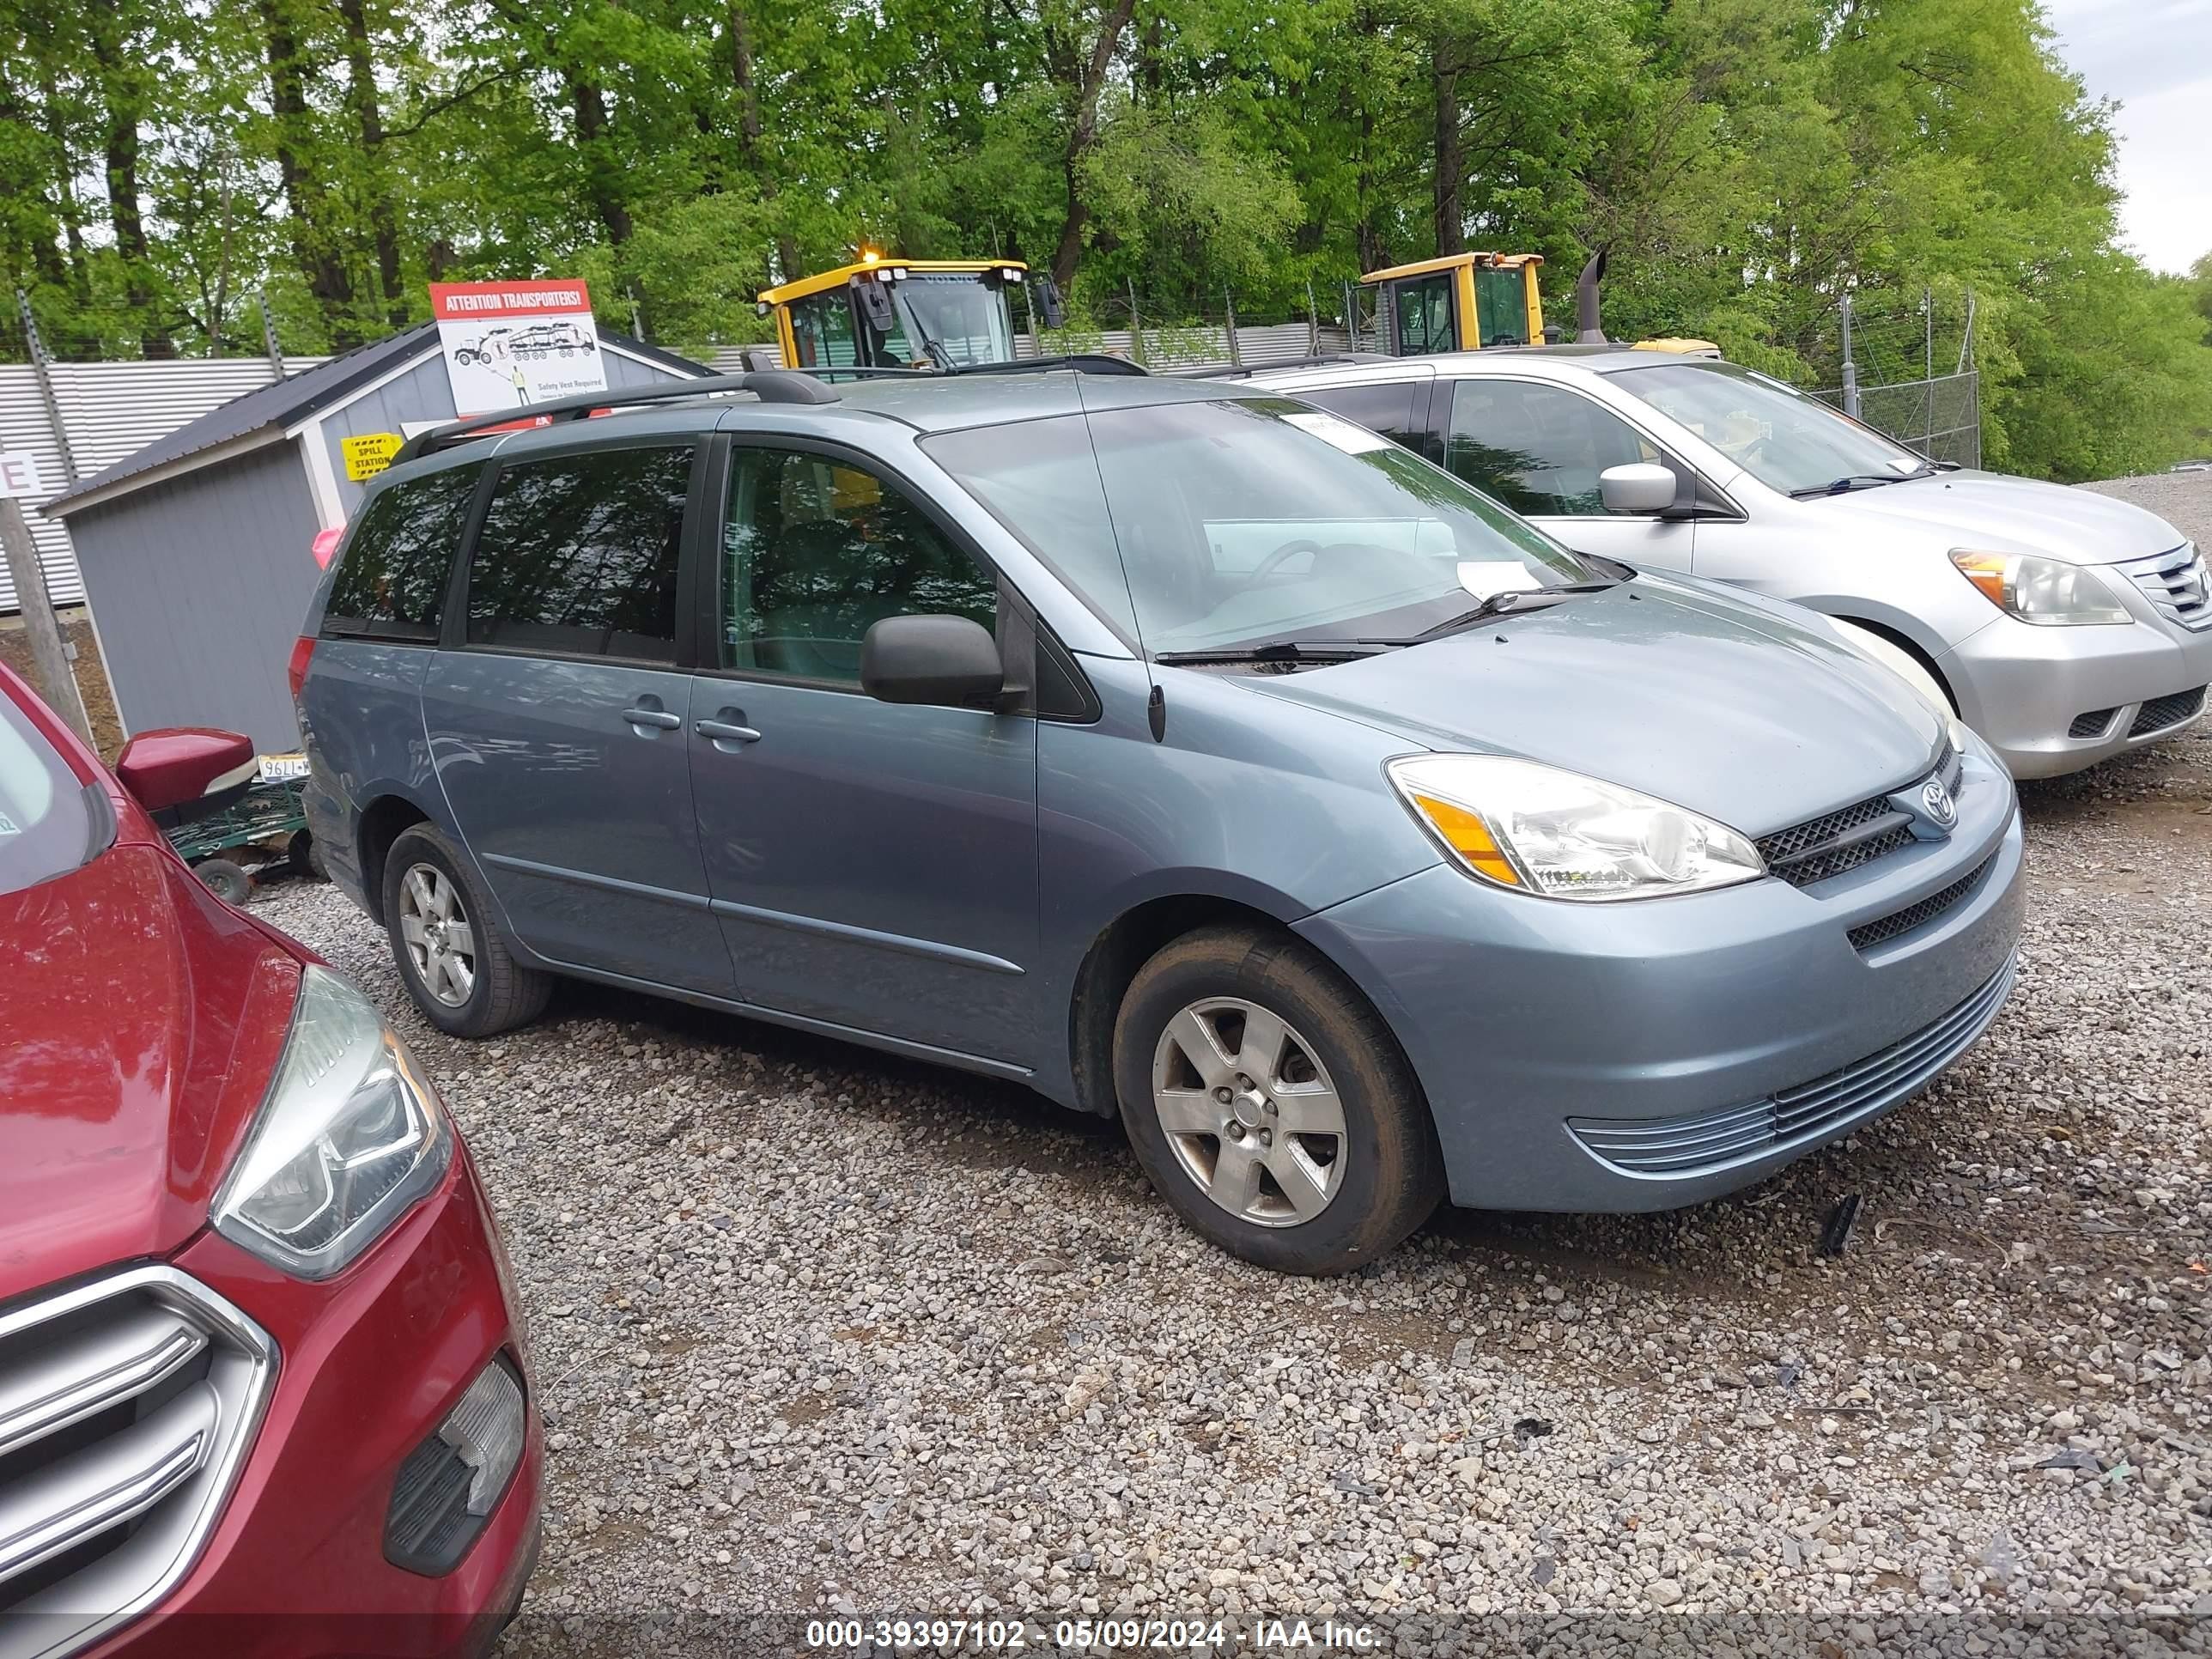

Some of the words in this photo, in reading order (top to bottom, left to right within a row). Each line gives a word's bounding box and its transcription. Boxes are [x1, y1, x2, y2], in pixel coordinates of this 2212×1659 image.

[447, 294, 502, 311] ATTENTION
[501, 291, 582, 309] TRANSPORTERS!
[574, 380, 602, 388] Required
[358, 447, 383, 457] SPILL
[355, 456, 391, 468] STATION
[1, 460, 31, 490] E
